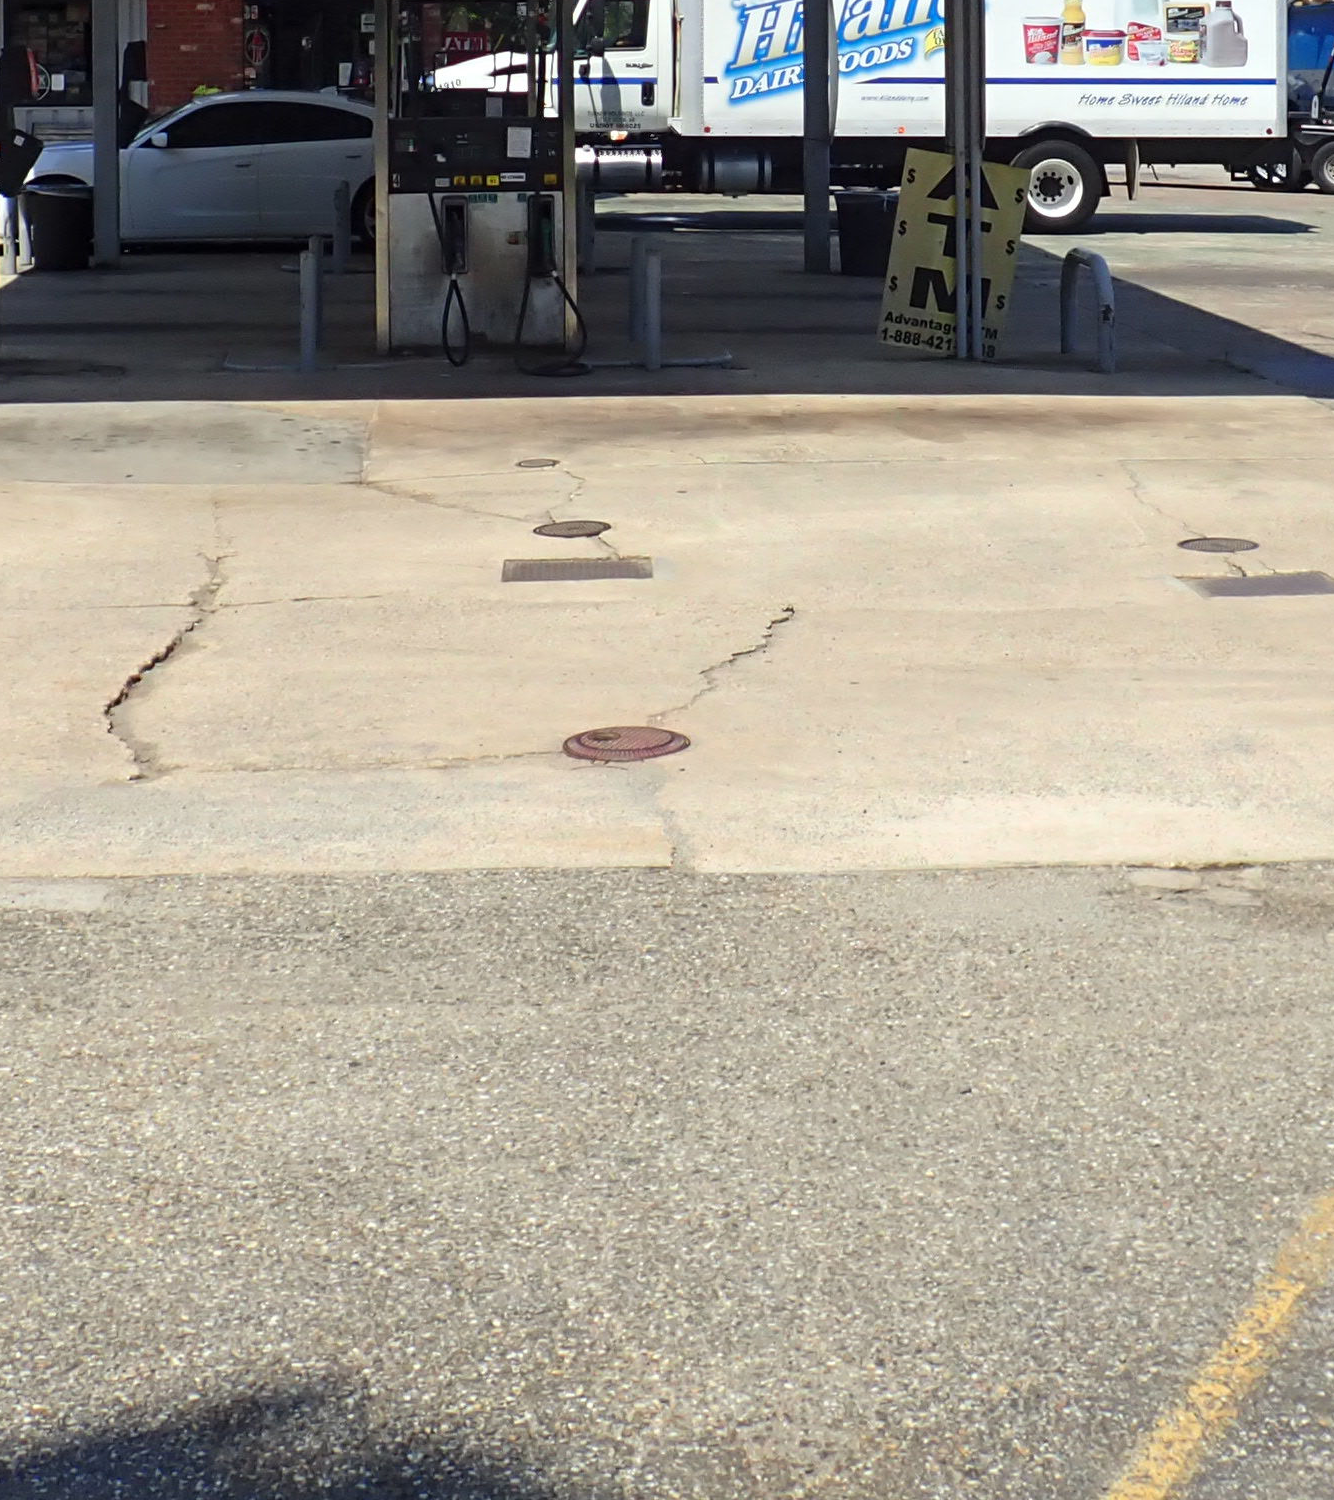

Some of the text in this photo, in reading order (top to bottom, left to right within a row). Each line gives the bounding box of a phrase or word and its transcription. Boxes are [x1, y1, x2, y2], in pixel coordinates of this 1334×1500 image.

[731, 65, 804, 99] DAIR
[837, 37, 914, 73] OODS
[1078, 93, 1249, 106] Home Sweet Hiland Home
[884, 311, 958, 335] Advantag
[881, 327, 996, 358] 1-888-421-8
